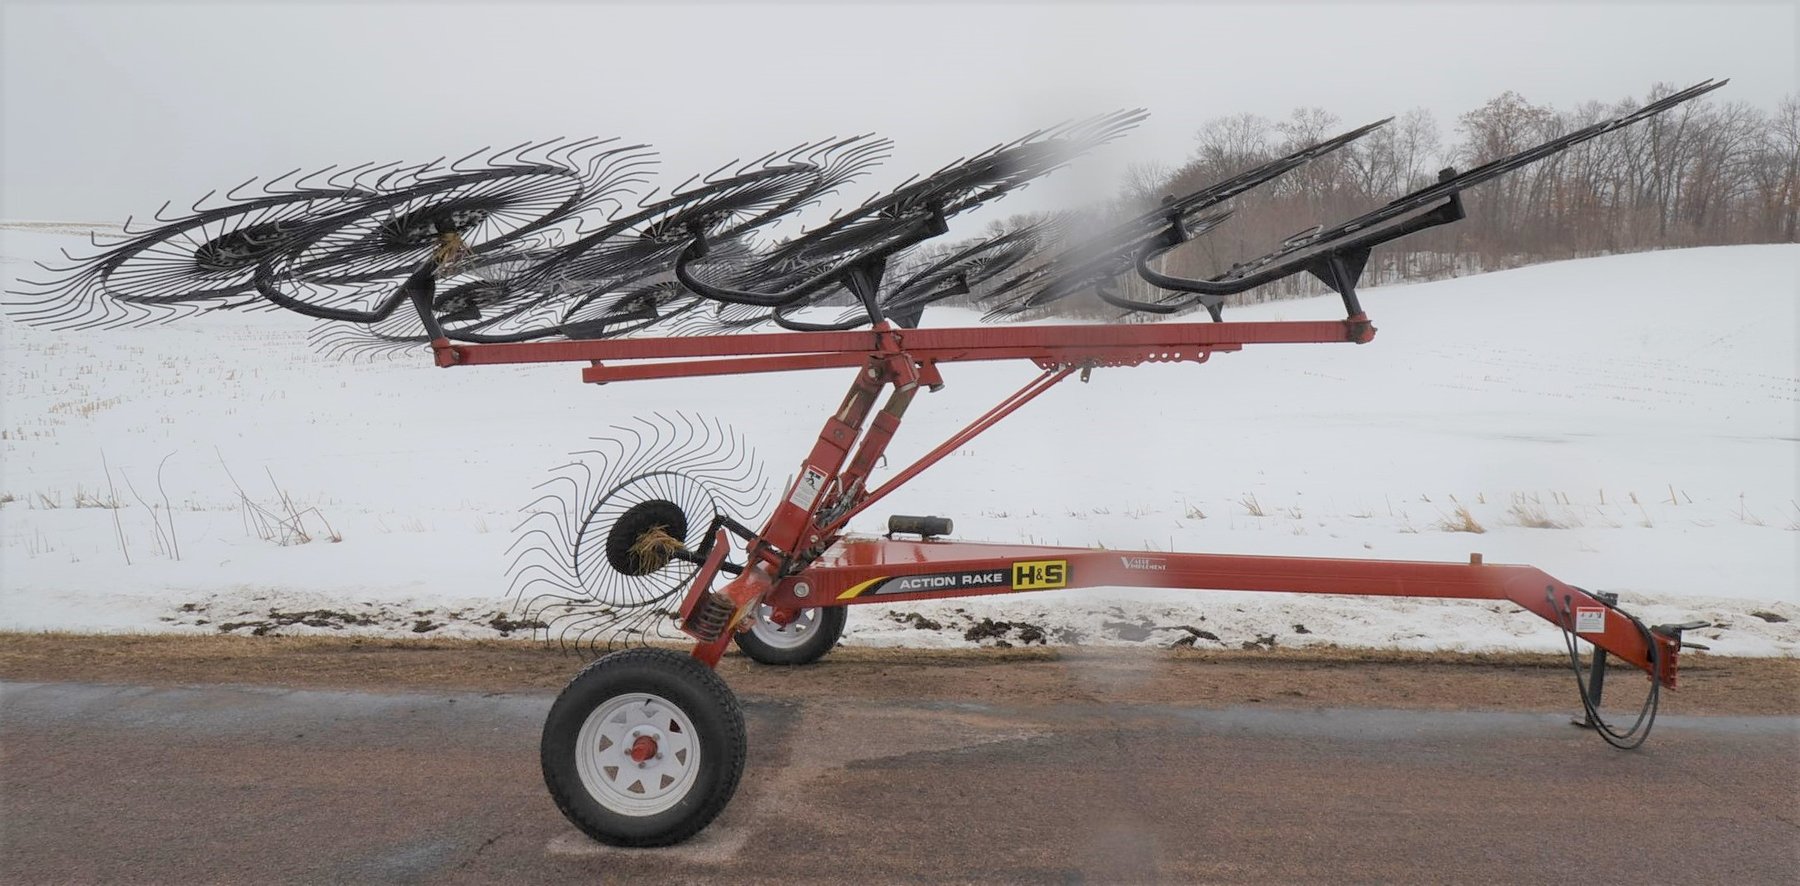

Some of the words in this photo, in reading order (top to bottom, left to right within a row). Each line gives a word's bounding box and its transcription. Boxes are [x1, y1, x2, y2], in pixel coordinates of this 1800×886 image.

[900, 578, 956, 589] ACTION
[962, 574, 1003, 585] RAKE
[1016, 565, 1063, 585] H&S
